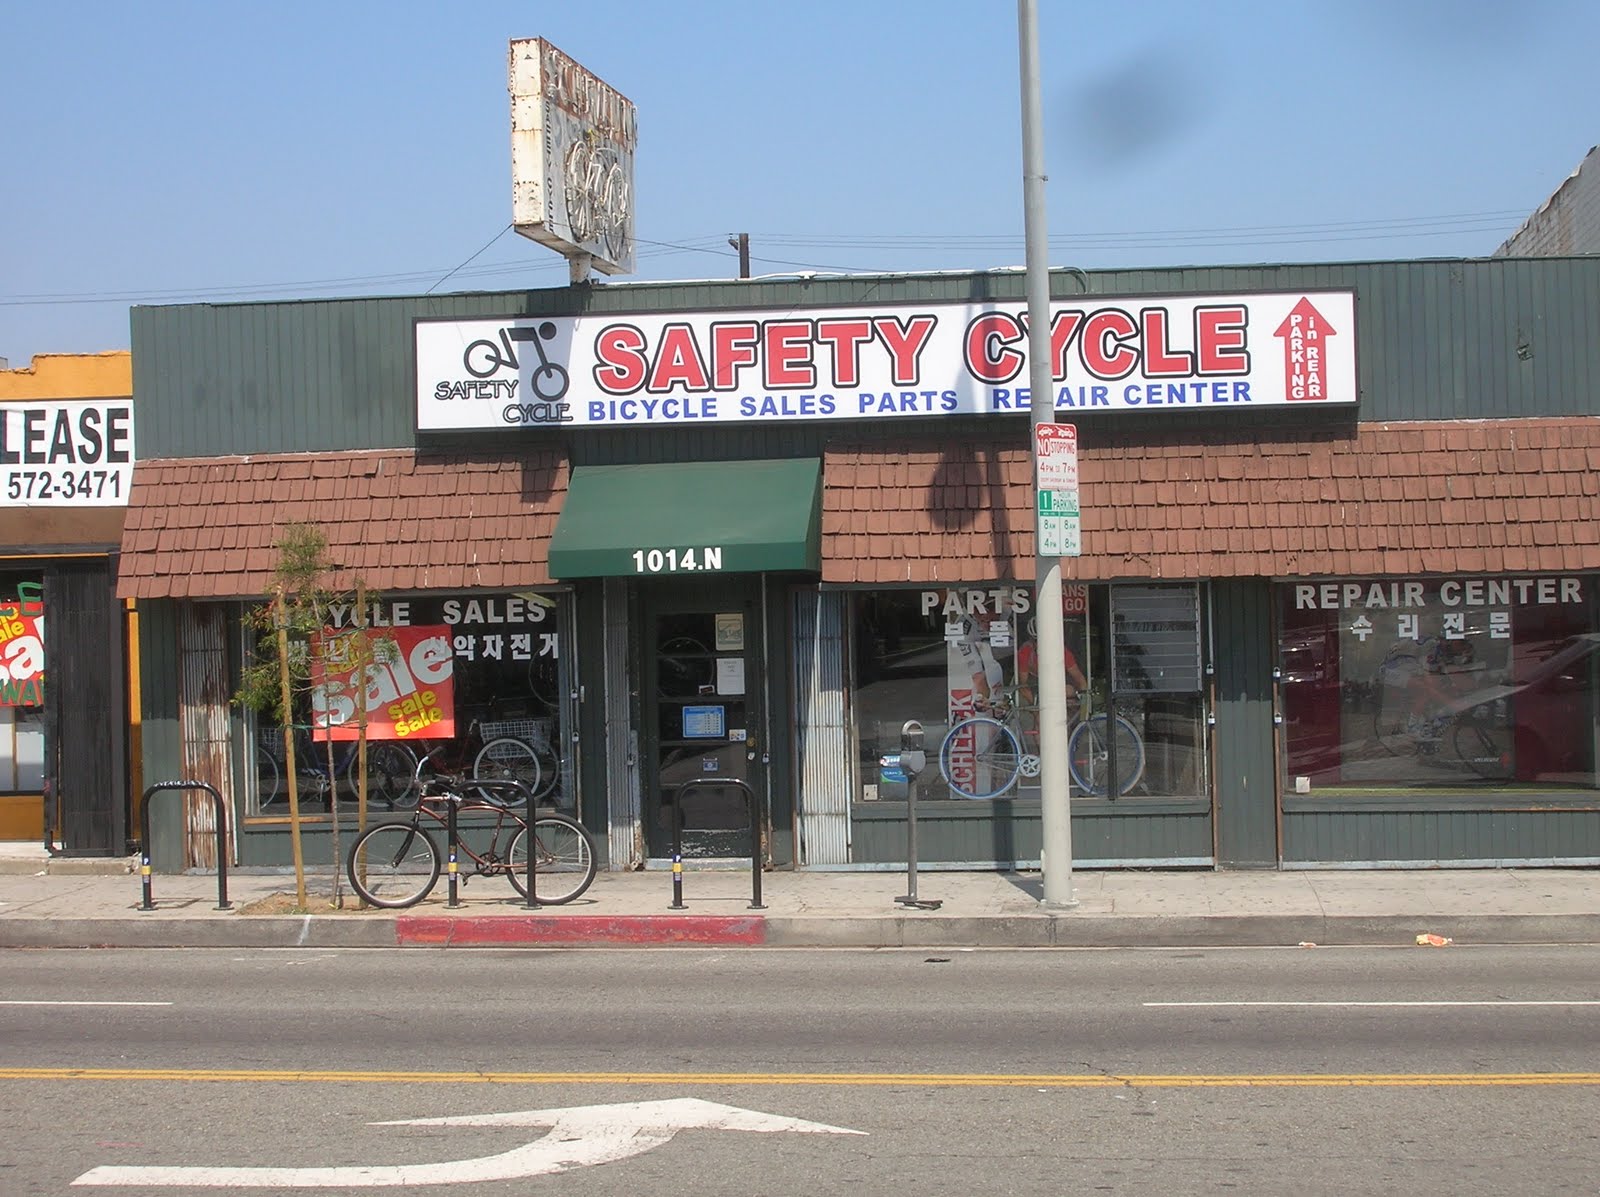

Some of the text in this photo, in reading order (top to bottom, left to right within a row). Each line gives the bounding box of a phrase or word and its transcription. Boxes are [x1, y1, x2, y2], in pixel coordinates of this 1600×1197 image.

[592, 304, 1251, 395] SAFETY CYCLE
[1290, 314, 1304, 399] PARKING
[1306, 316, 1321, 397] in REAR
[435, 379, 519, 400] SAFETY
[588, 382, 1251, 421] BICYCLE SALES PARTS REAIR CENTER
[502, 403, 573, 423] CYCLE
[0, 408, 129, 464] LEASE
[1038, 438, 1076, 455] NO STOPPING
[8, 470, 120, 499] 572-3471
[1043, 492, 1048, 509] 1
[1053, 499, 1077, 511] PARKING
[633, 547, 722, 573] 1014.N
[922, 588, 1030, 616] PARTS
[1296, 578, 1582, 609] REPAIR CENTER
[443, 599, 546, 625] SALES
[312, 637, 453, 728] sale
[388, 691, 437, 720] sale
[395, 707, 443, 737] sale
